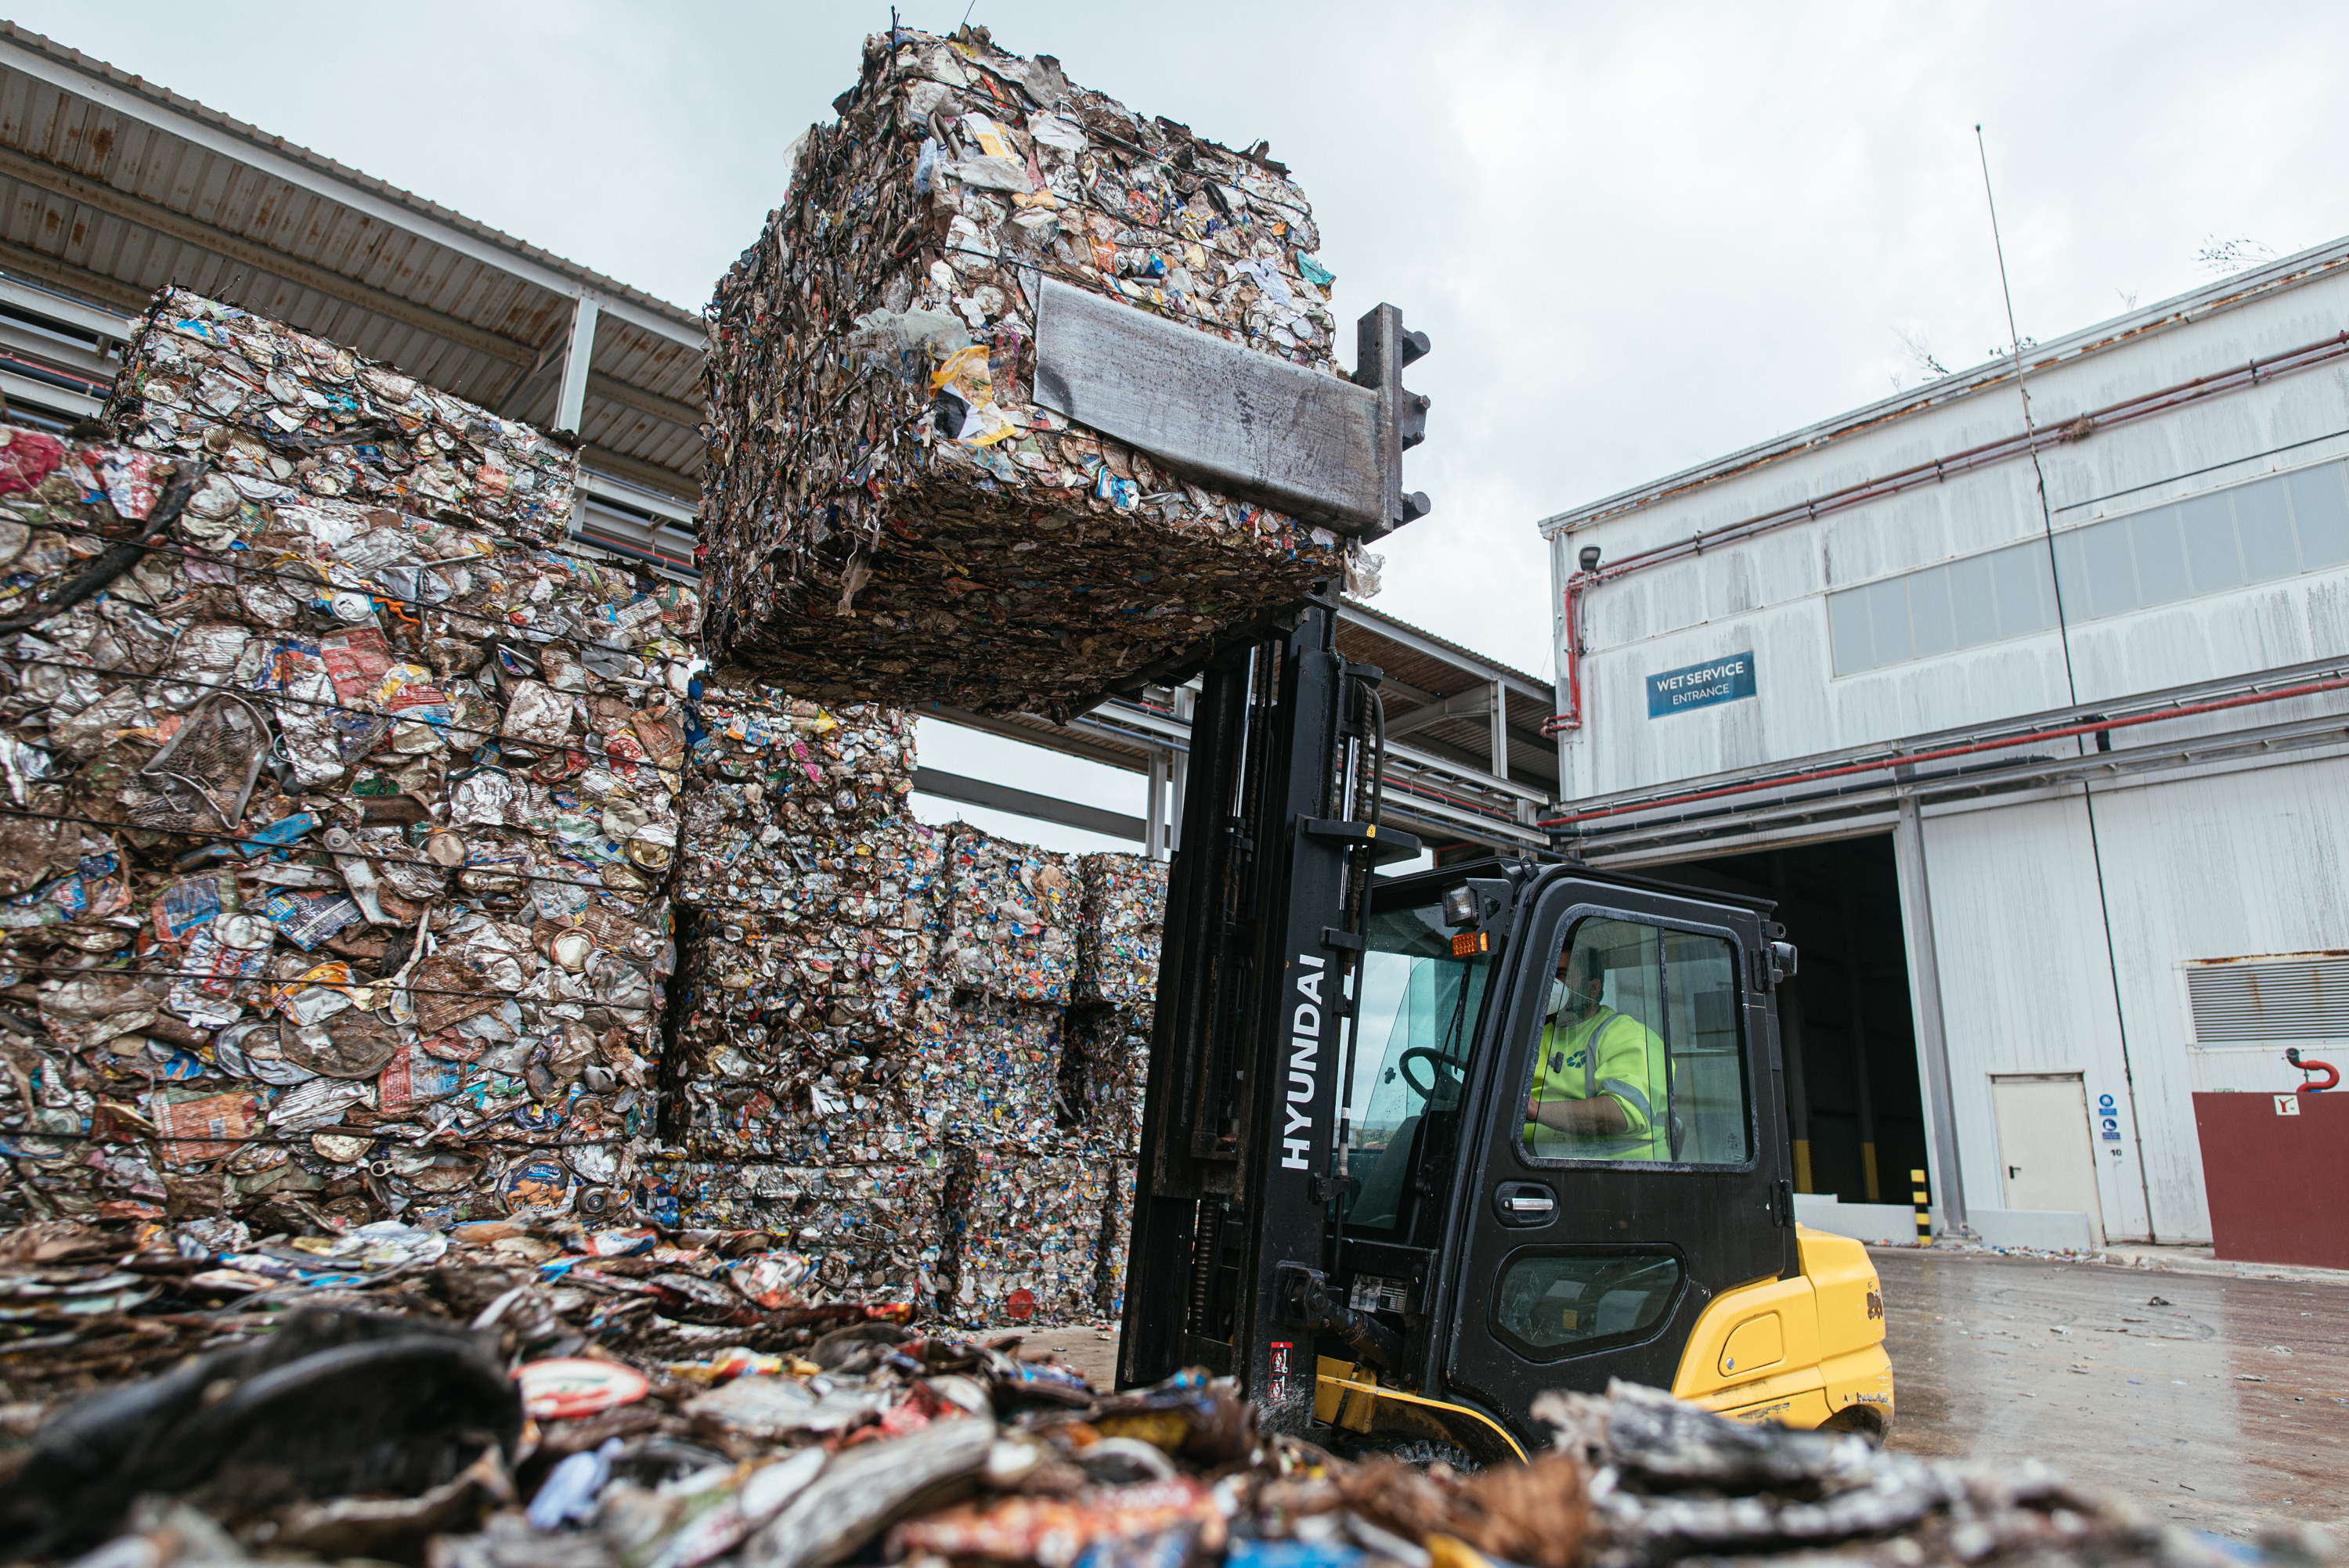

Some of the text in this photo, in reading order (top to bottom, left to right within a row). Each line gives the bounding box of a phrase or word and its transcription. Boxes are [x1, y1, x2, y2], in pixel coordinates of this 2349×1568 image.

[1657, 661, 1744, 692] WET SERVICE
[1672, 683, 1730, 705] ENTRANCE
[1281, 953, 1326, 1170] HYUNDAI
[514, 1201, 556, 1213] Mssels
